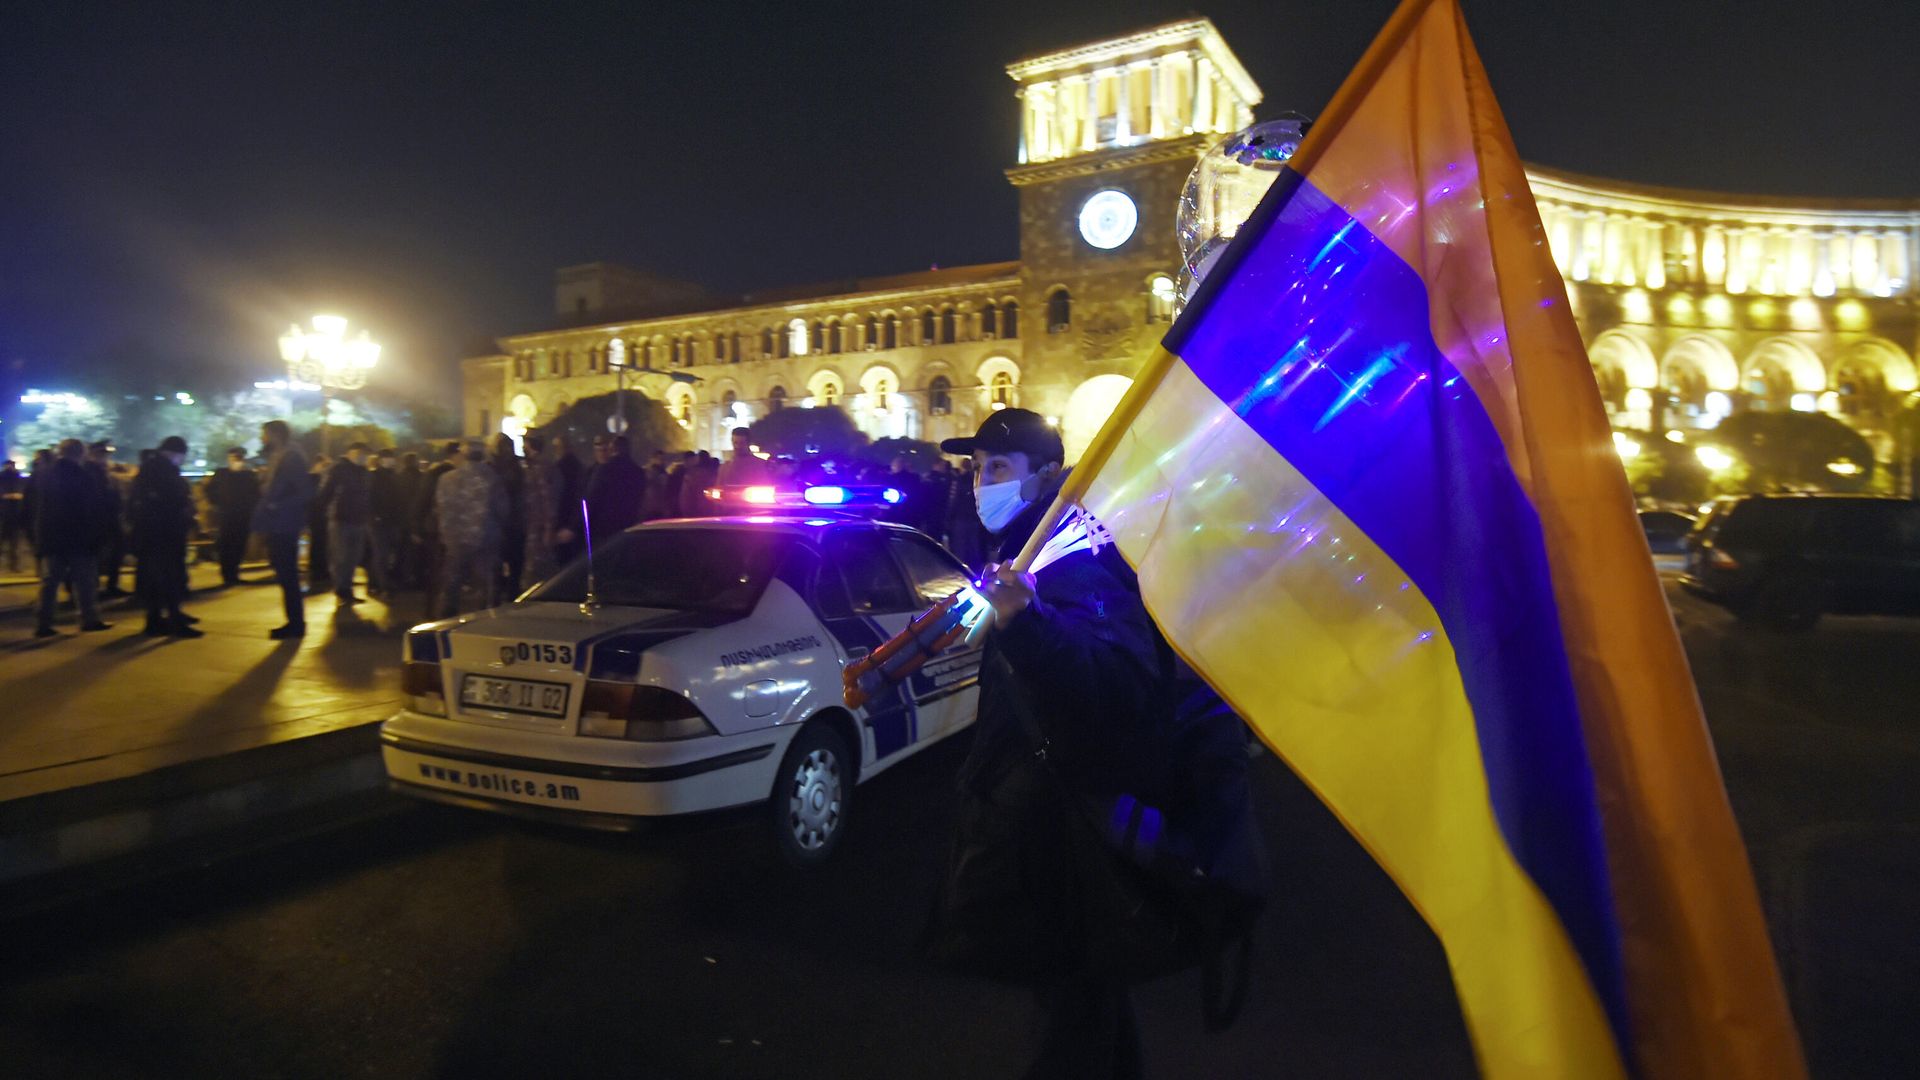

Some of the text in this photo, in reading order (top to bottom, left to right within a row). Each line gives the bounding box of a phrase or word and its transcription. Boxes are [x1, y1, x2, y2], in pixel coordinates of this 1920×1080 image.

[517, 641, 572, 664] 0153
[542, 687, 563, 710] 02
[418, 763, 580, 801] www.police.am
